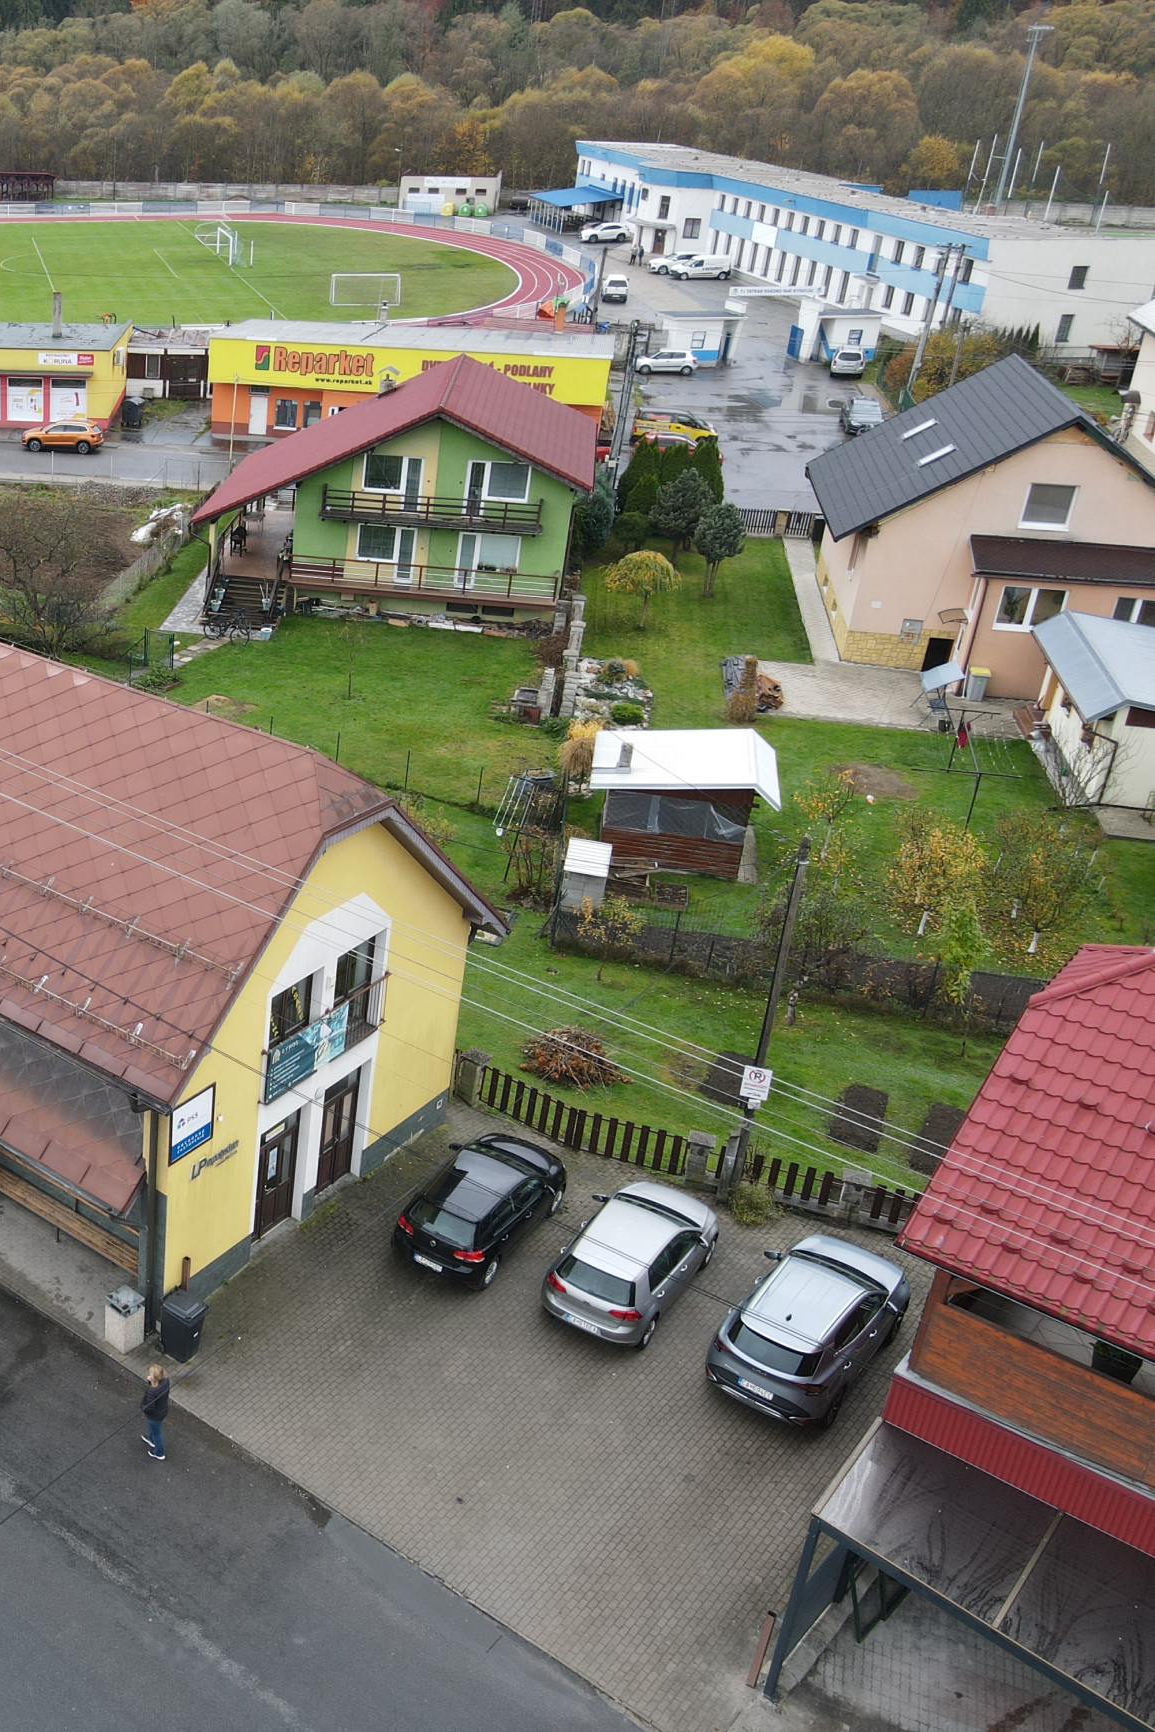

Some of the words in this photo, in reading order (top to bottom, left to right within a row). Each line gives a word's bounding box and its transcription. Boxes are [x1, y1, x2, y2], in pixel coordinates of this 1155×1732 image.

[273, 346, 374, 377] Reparket
[503, 363, 555, 379] PODLAHY
[315, 377, 373, 386] www.reparket.sk
